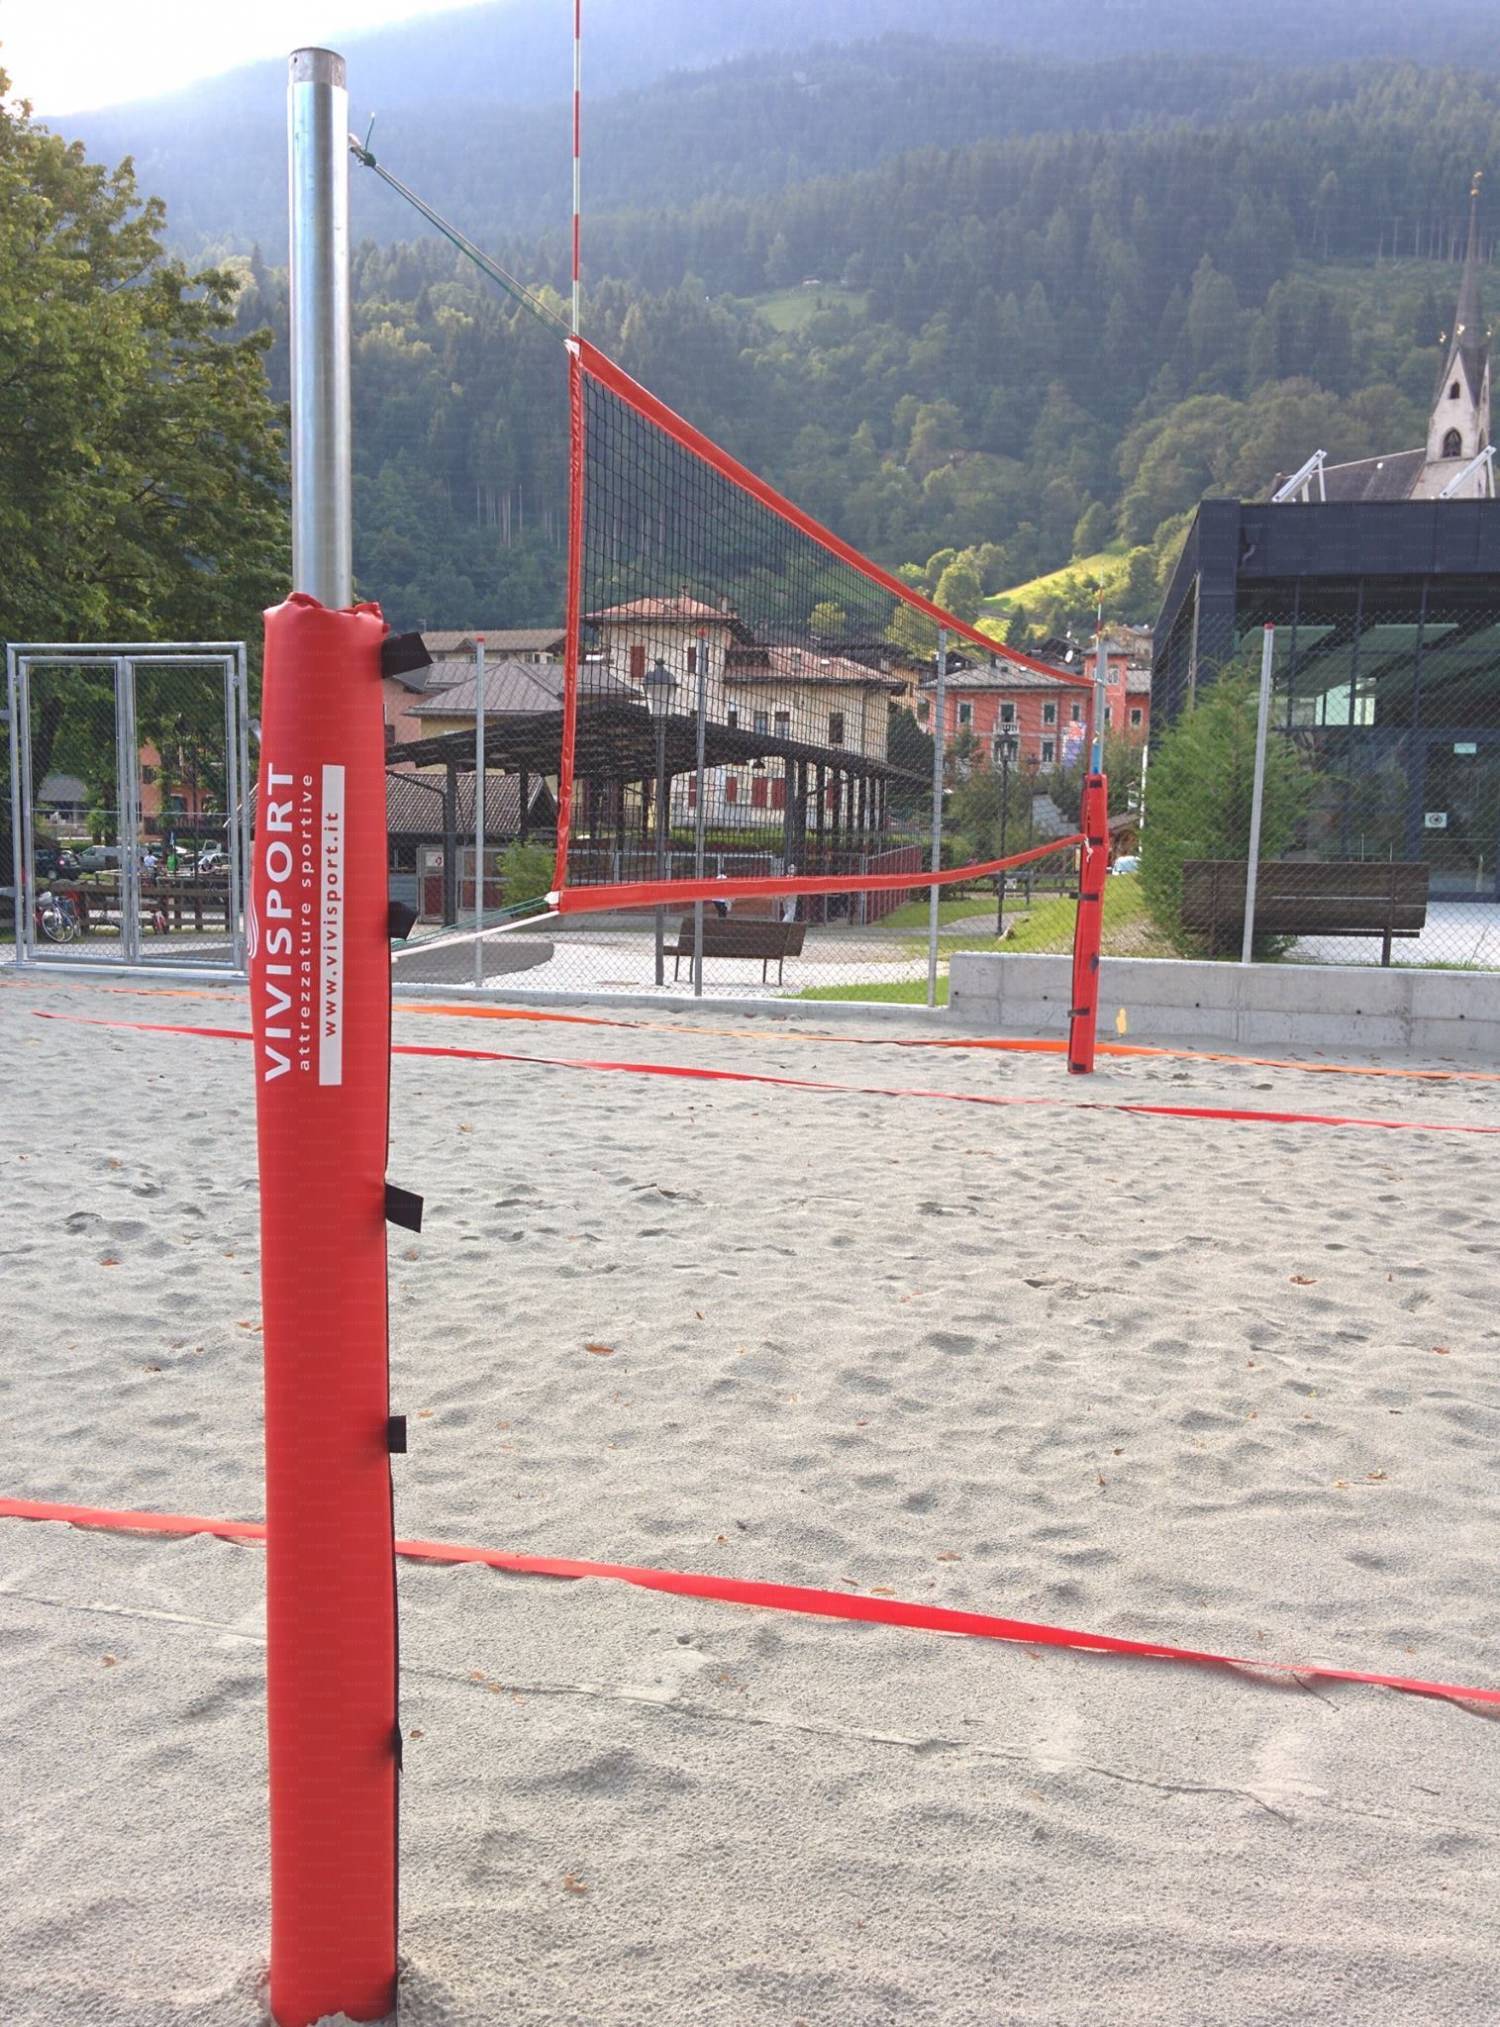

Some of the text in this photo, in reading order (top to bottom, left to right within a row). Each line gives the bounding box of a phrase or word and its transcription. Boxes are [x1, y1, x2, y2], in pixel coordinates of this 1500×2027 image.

[265, 762, 293, 1082] VIVISPORT
[299, 775, 314, 1071] attrezzature sportive
[324, 812, 341, 1037] www.vivisport.it
